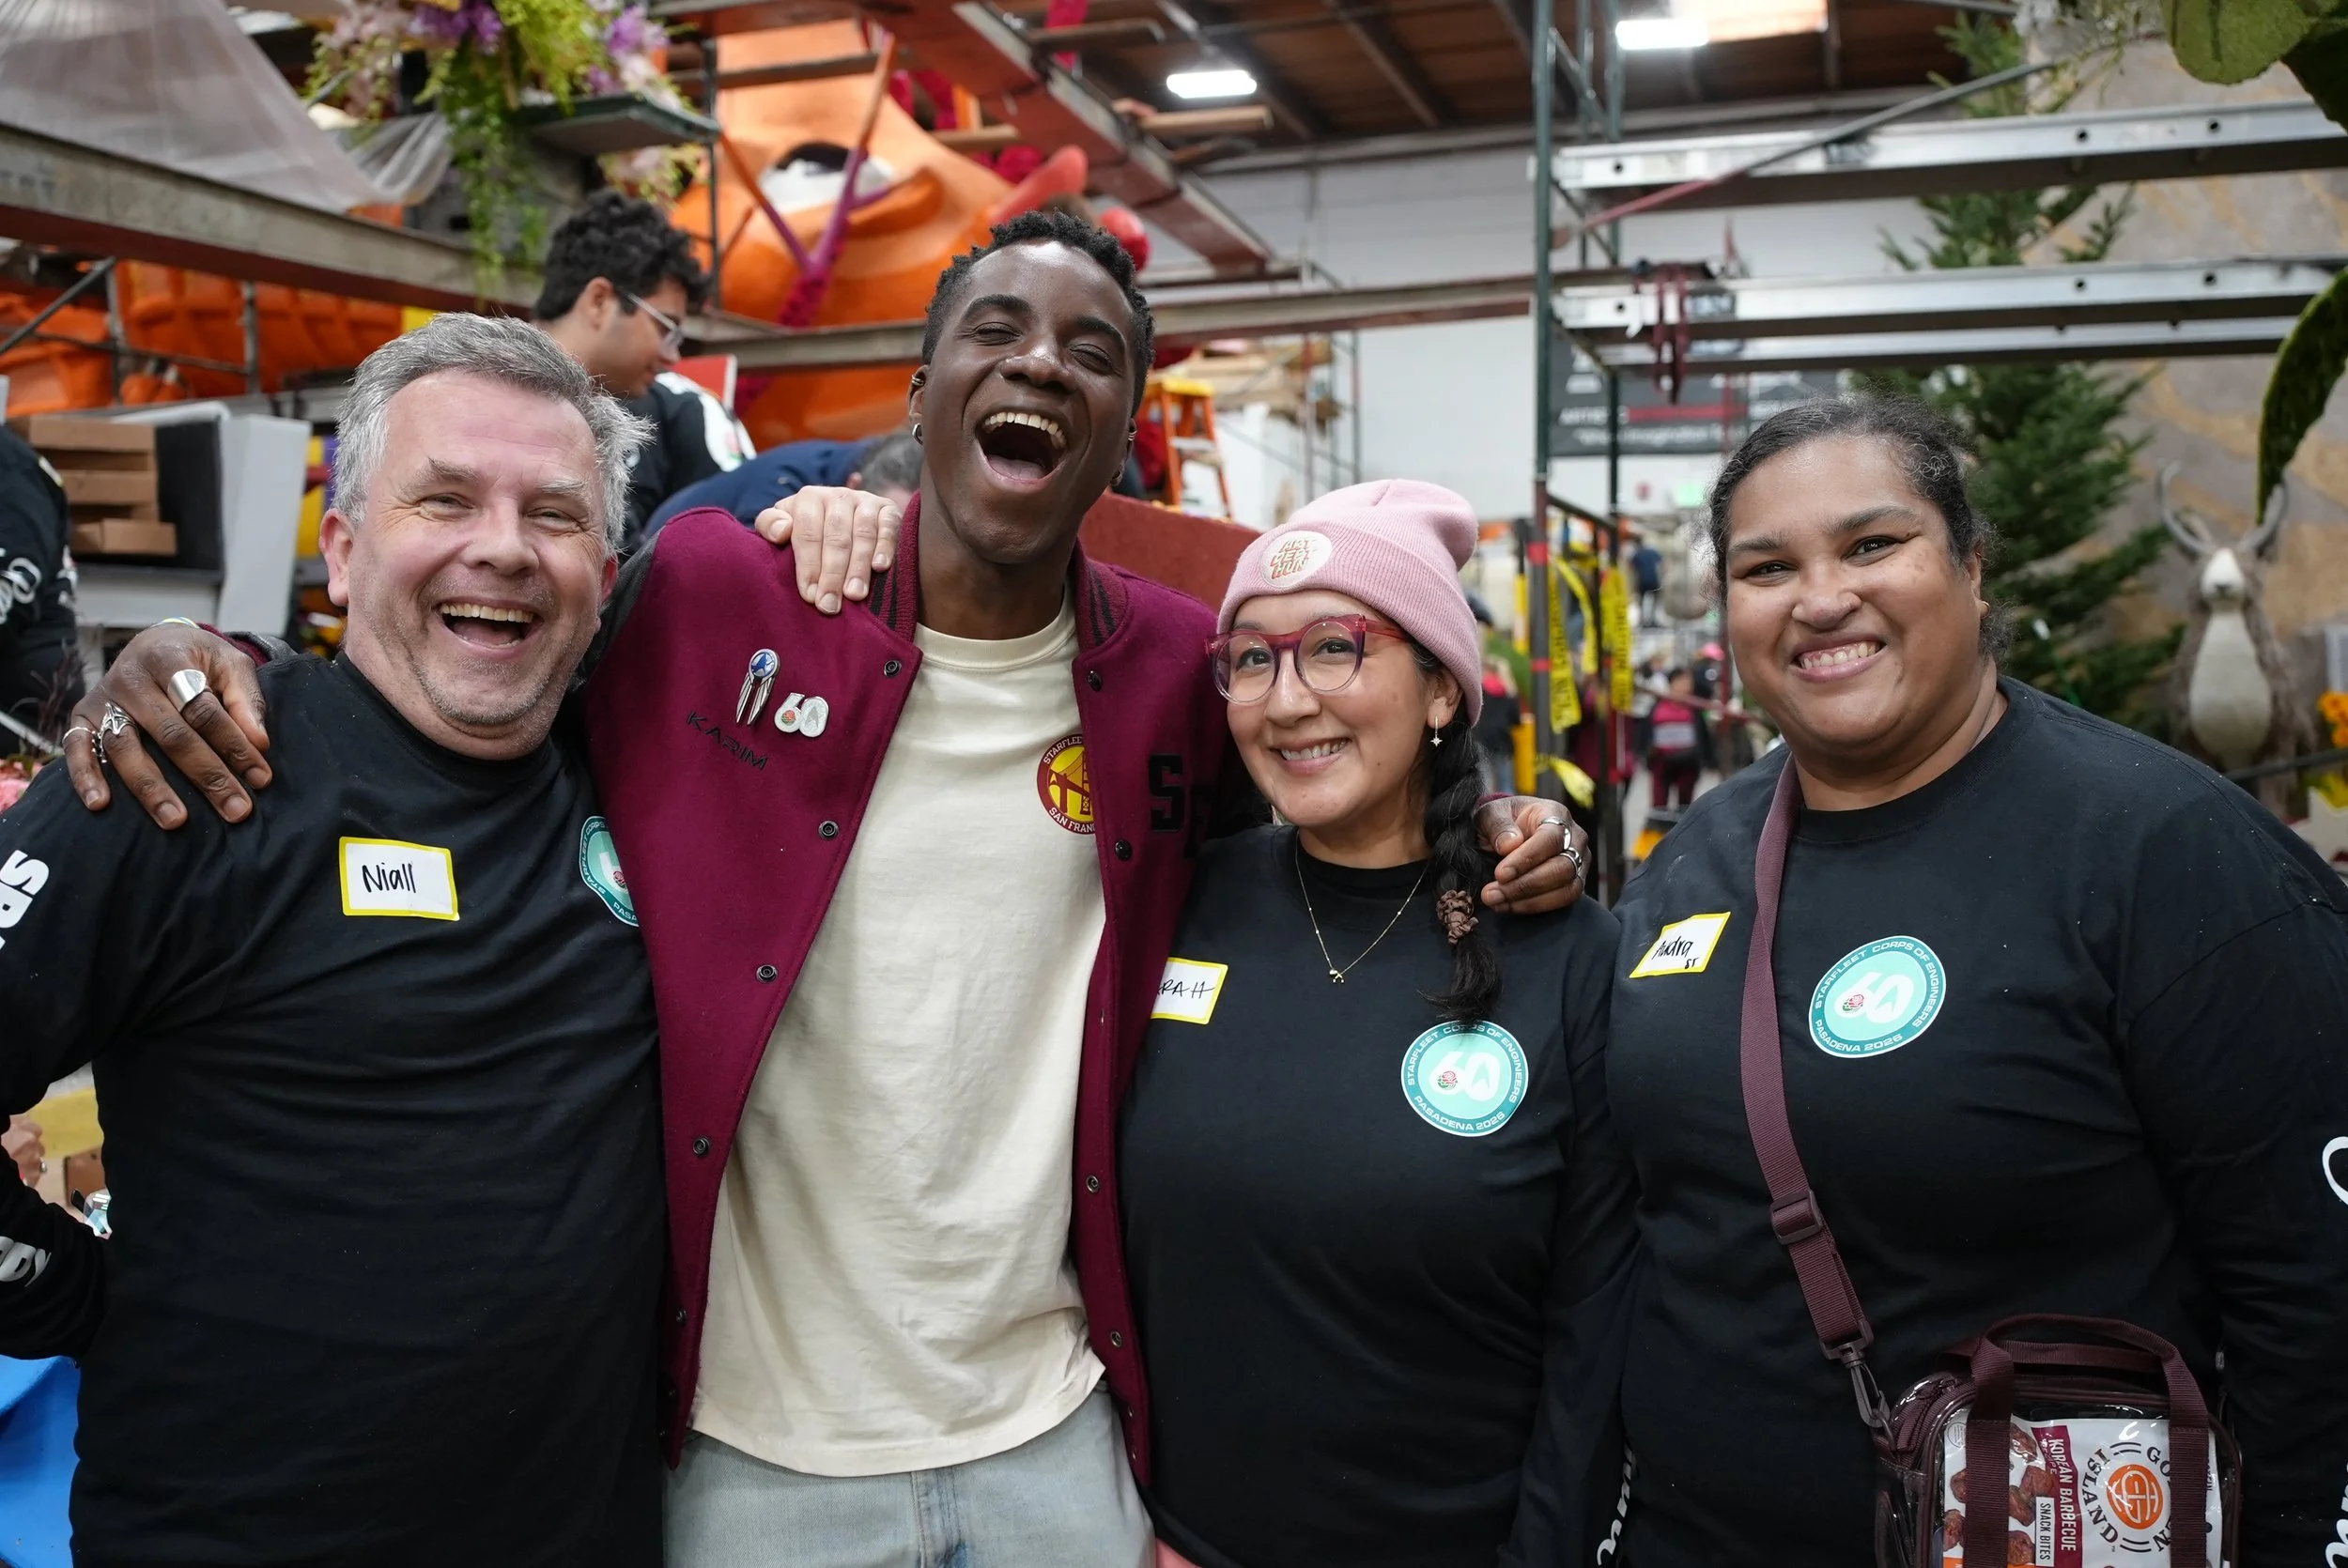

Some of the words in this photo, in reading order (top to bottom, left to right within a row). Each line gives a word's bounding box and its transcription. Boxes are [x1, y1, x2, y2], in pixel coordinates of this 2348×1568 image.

[687, 711, 768, 771] KARIM
[1043, 736, 1083, 764] STARFLEE
[1049, 807, 1068, 826] SAN
[362, 862, 416, 893] Niall
[581, 835, 606, 895] STARFLEET
[1872, 941, 1914, 953] CORPS
[1913, 948, 1930, 962] OF
[1158, 978, 1216, 999] RAH
[1815, 949, 1867, 1008] STARFLEET
[1912, 961, 1939, 1028] ENGINEERS
[1815, 1019, 1861, 1052] PASADENA
[1864, 1034, 1904, 1052] 2026
[1408, 1031, 1439, 1086] STARFLEET
[1487, 1027, 1502, 1038] OF
[1501, 1037, 1522, 1103] ENGINEERS
[1414, 1096, 1474, 1130] PASADENA
[1475, 1112, 1506, 1130] 2026
[2048, 1438, 2073, 1483] KOREAN
[2081, 1448, 2119, 1544] ISLAND
[2040, 1502, 2051, 1532] SNACK
[2060, 1488, 2077, 1551] BARBECUE
[2040, 1535, 2051, 1560] BITES
